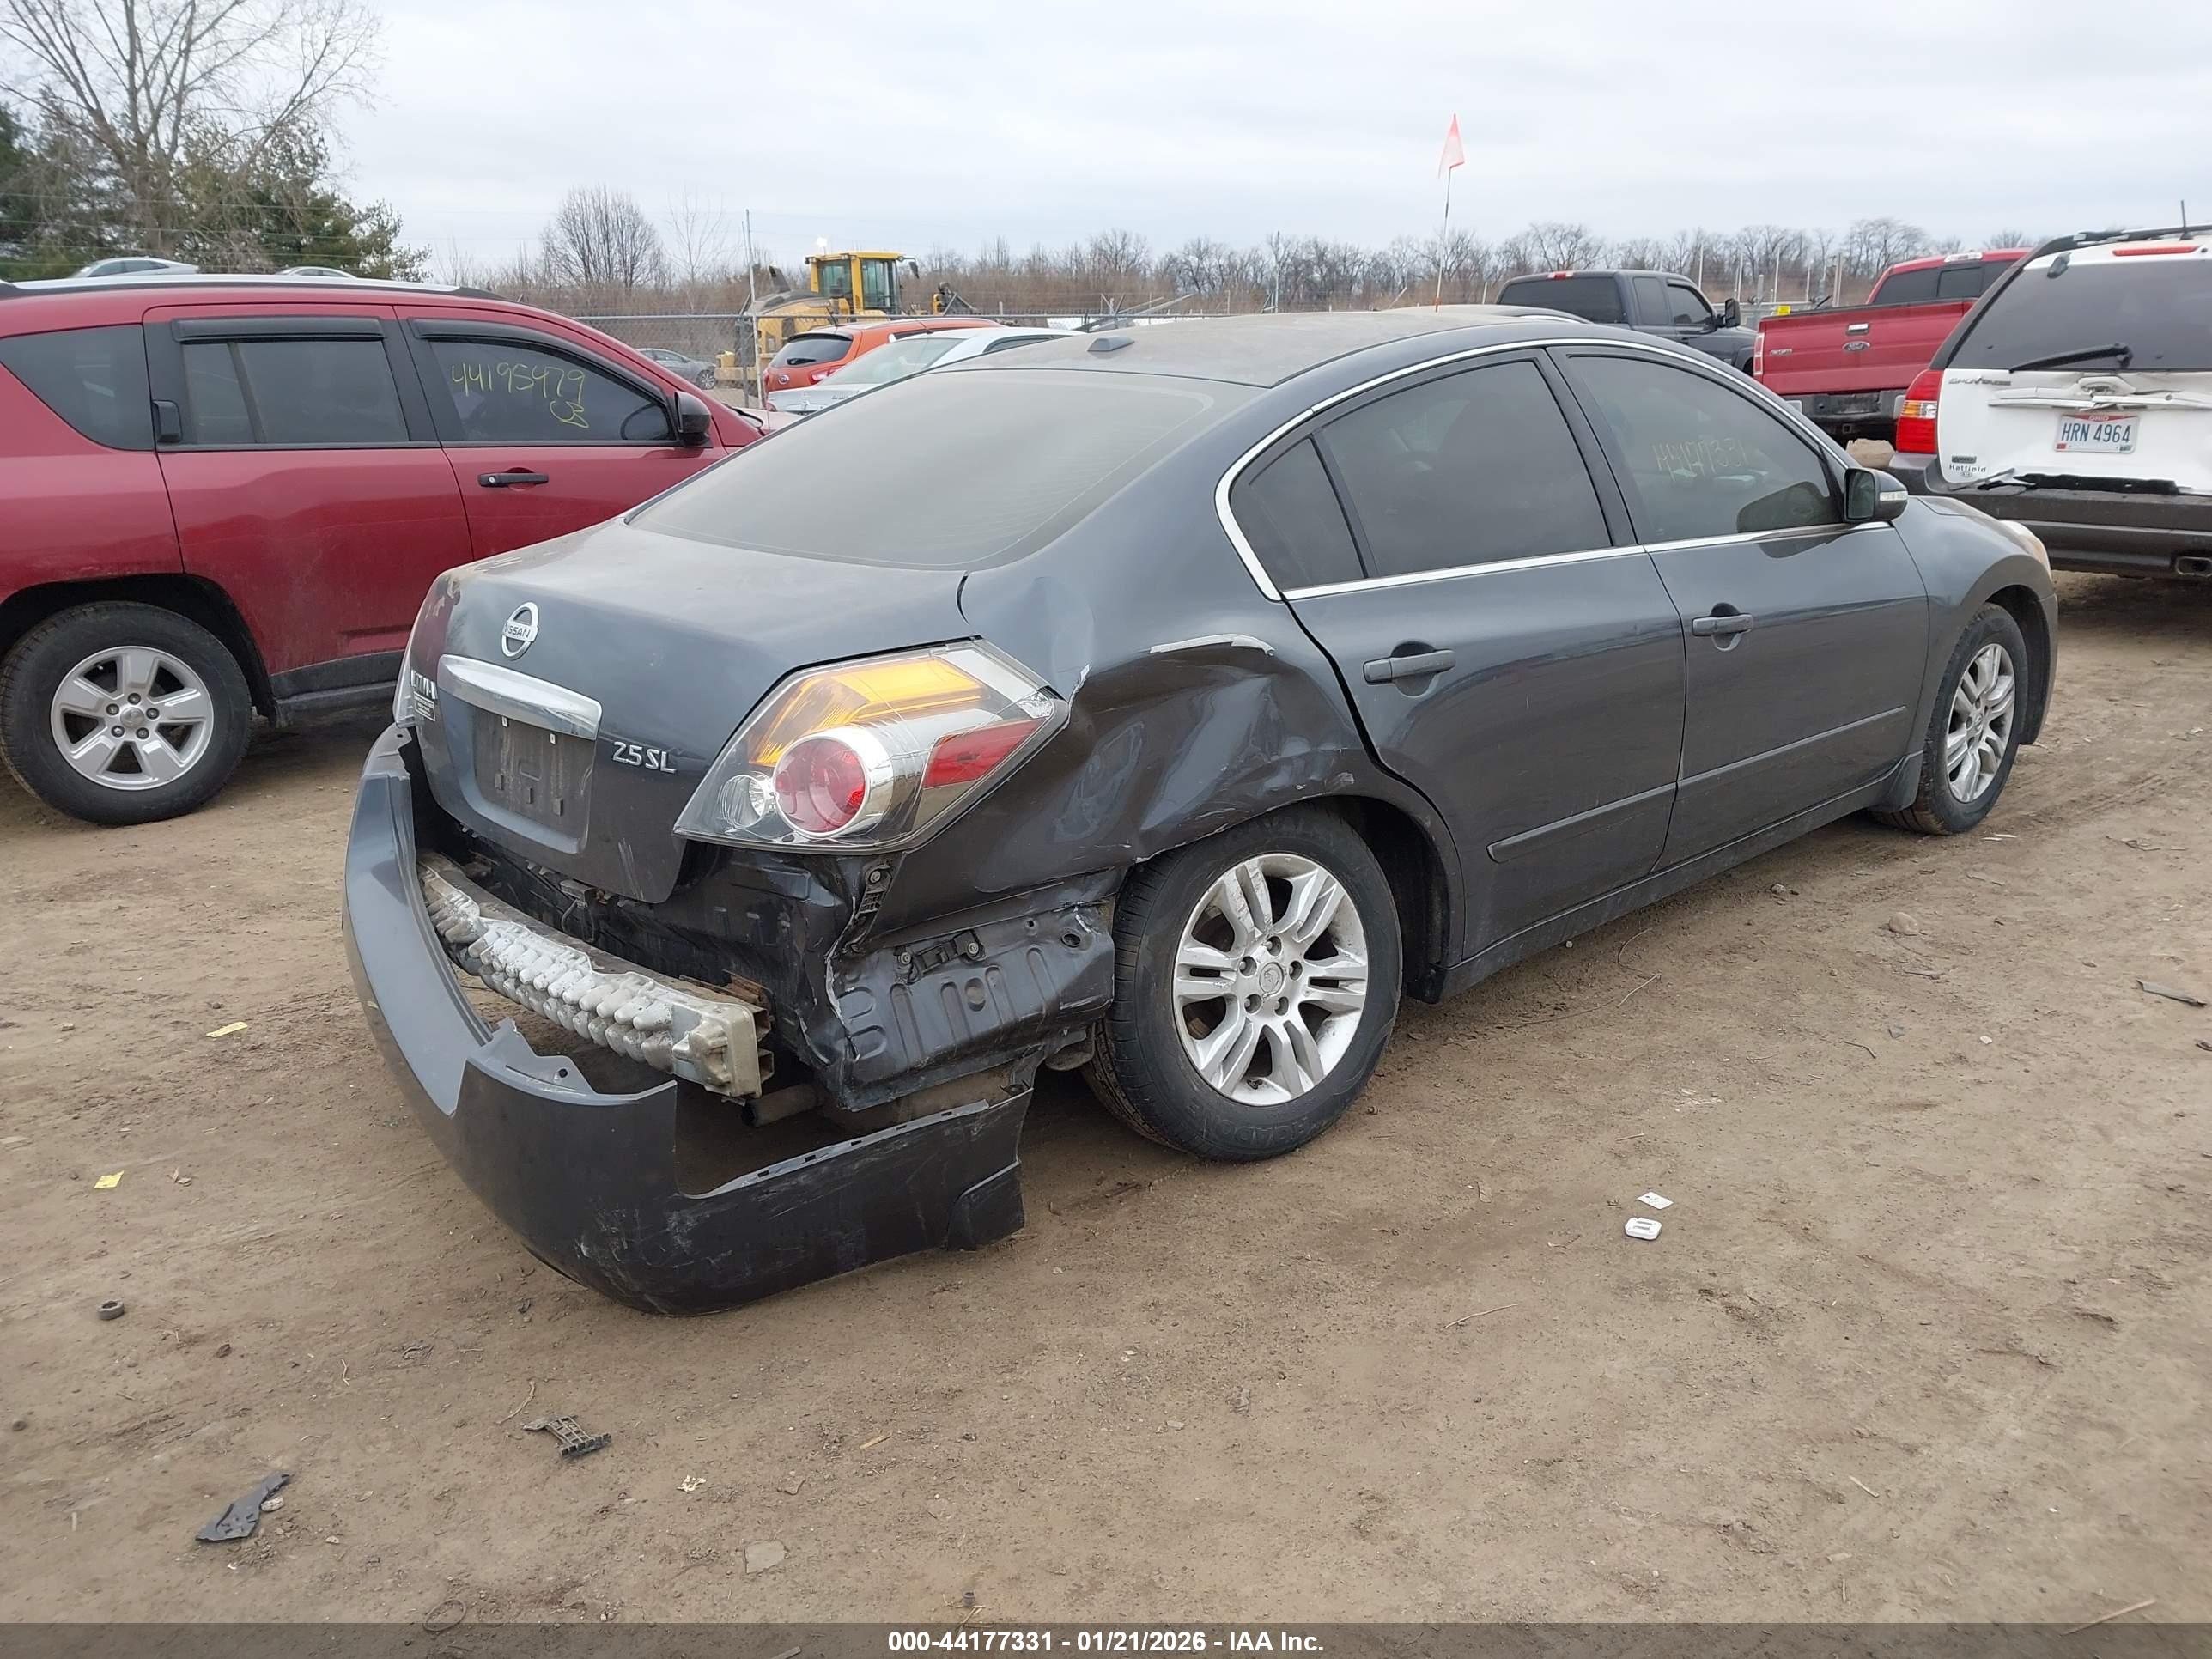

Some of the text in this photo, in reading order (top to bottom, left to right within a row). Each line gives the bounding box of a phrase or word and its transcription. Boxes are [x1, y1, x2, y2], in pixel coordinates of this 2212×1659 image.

[452, 362, 586, 404] 44195479
[2061, 422, 2131, 443] HRN 4964
[503, 622, 532, 638] ISSAN
